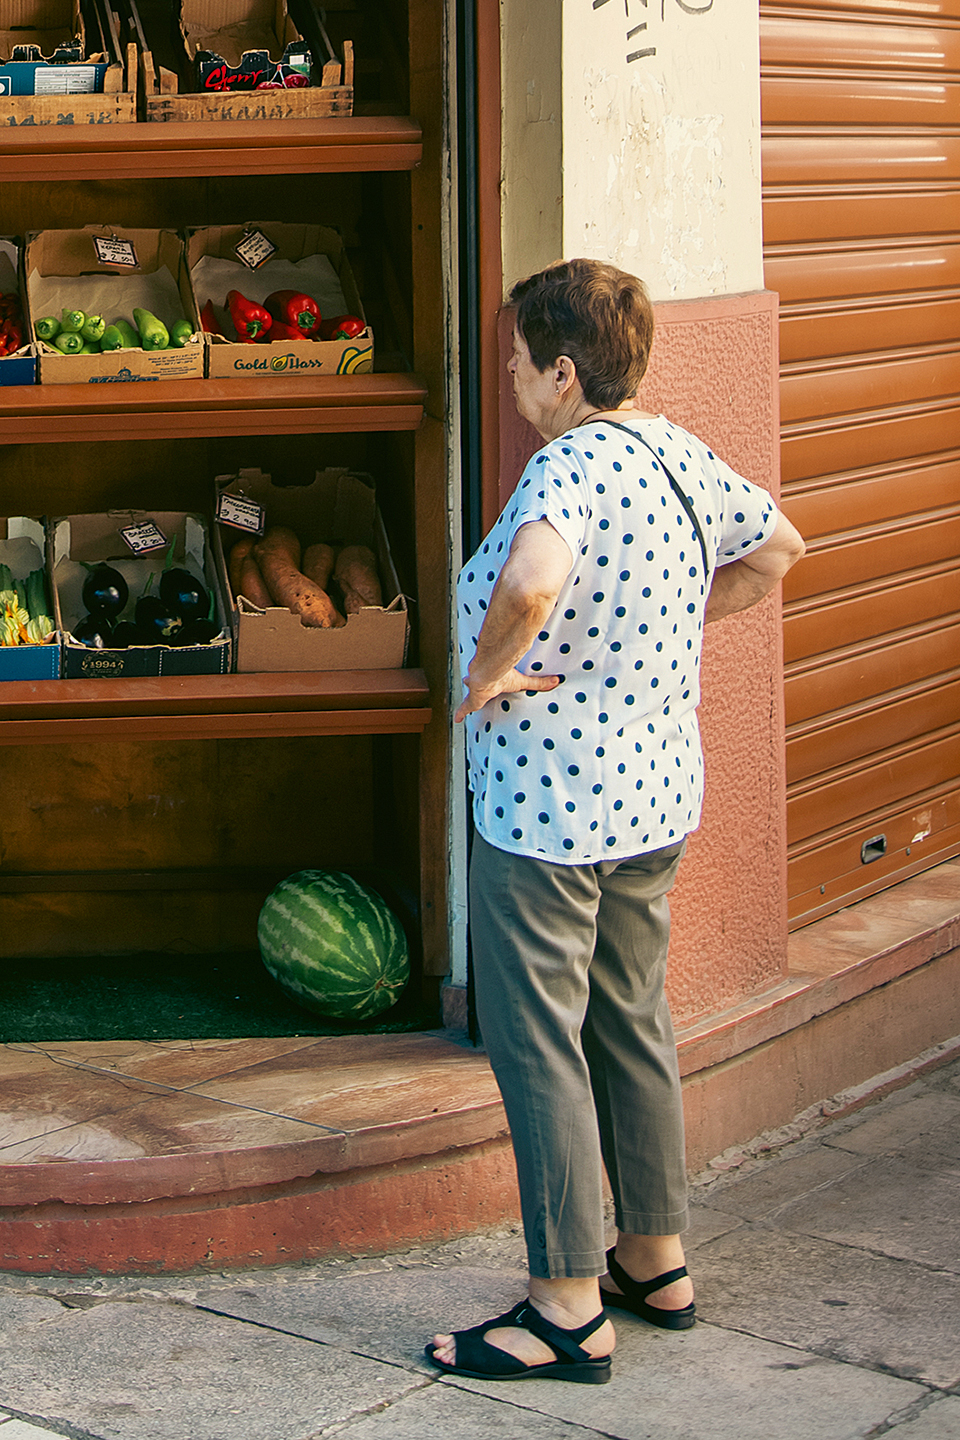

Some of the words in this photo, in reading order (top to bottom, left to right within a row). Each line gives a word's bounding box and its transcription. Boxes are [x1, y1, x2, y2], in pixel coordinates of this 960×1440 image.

[205, 64, 263, 90] Cherry
[233, 358, 270, 370] Gold
[289, 357, 323, 370] Hass
[90, 660, 116, 669] 1994
